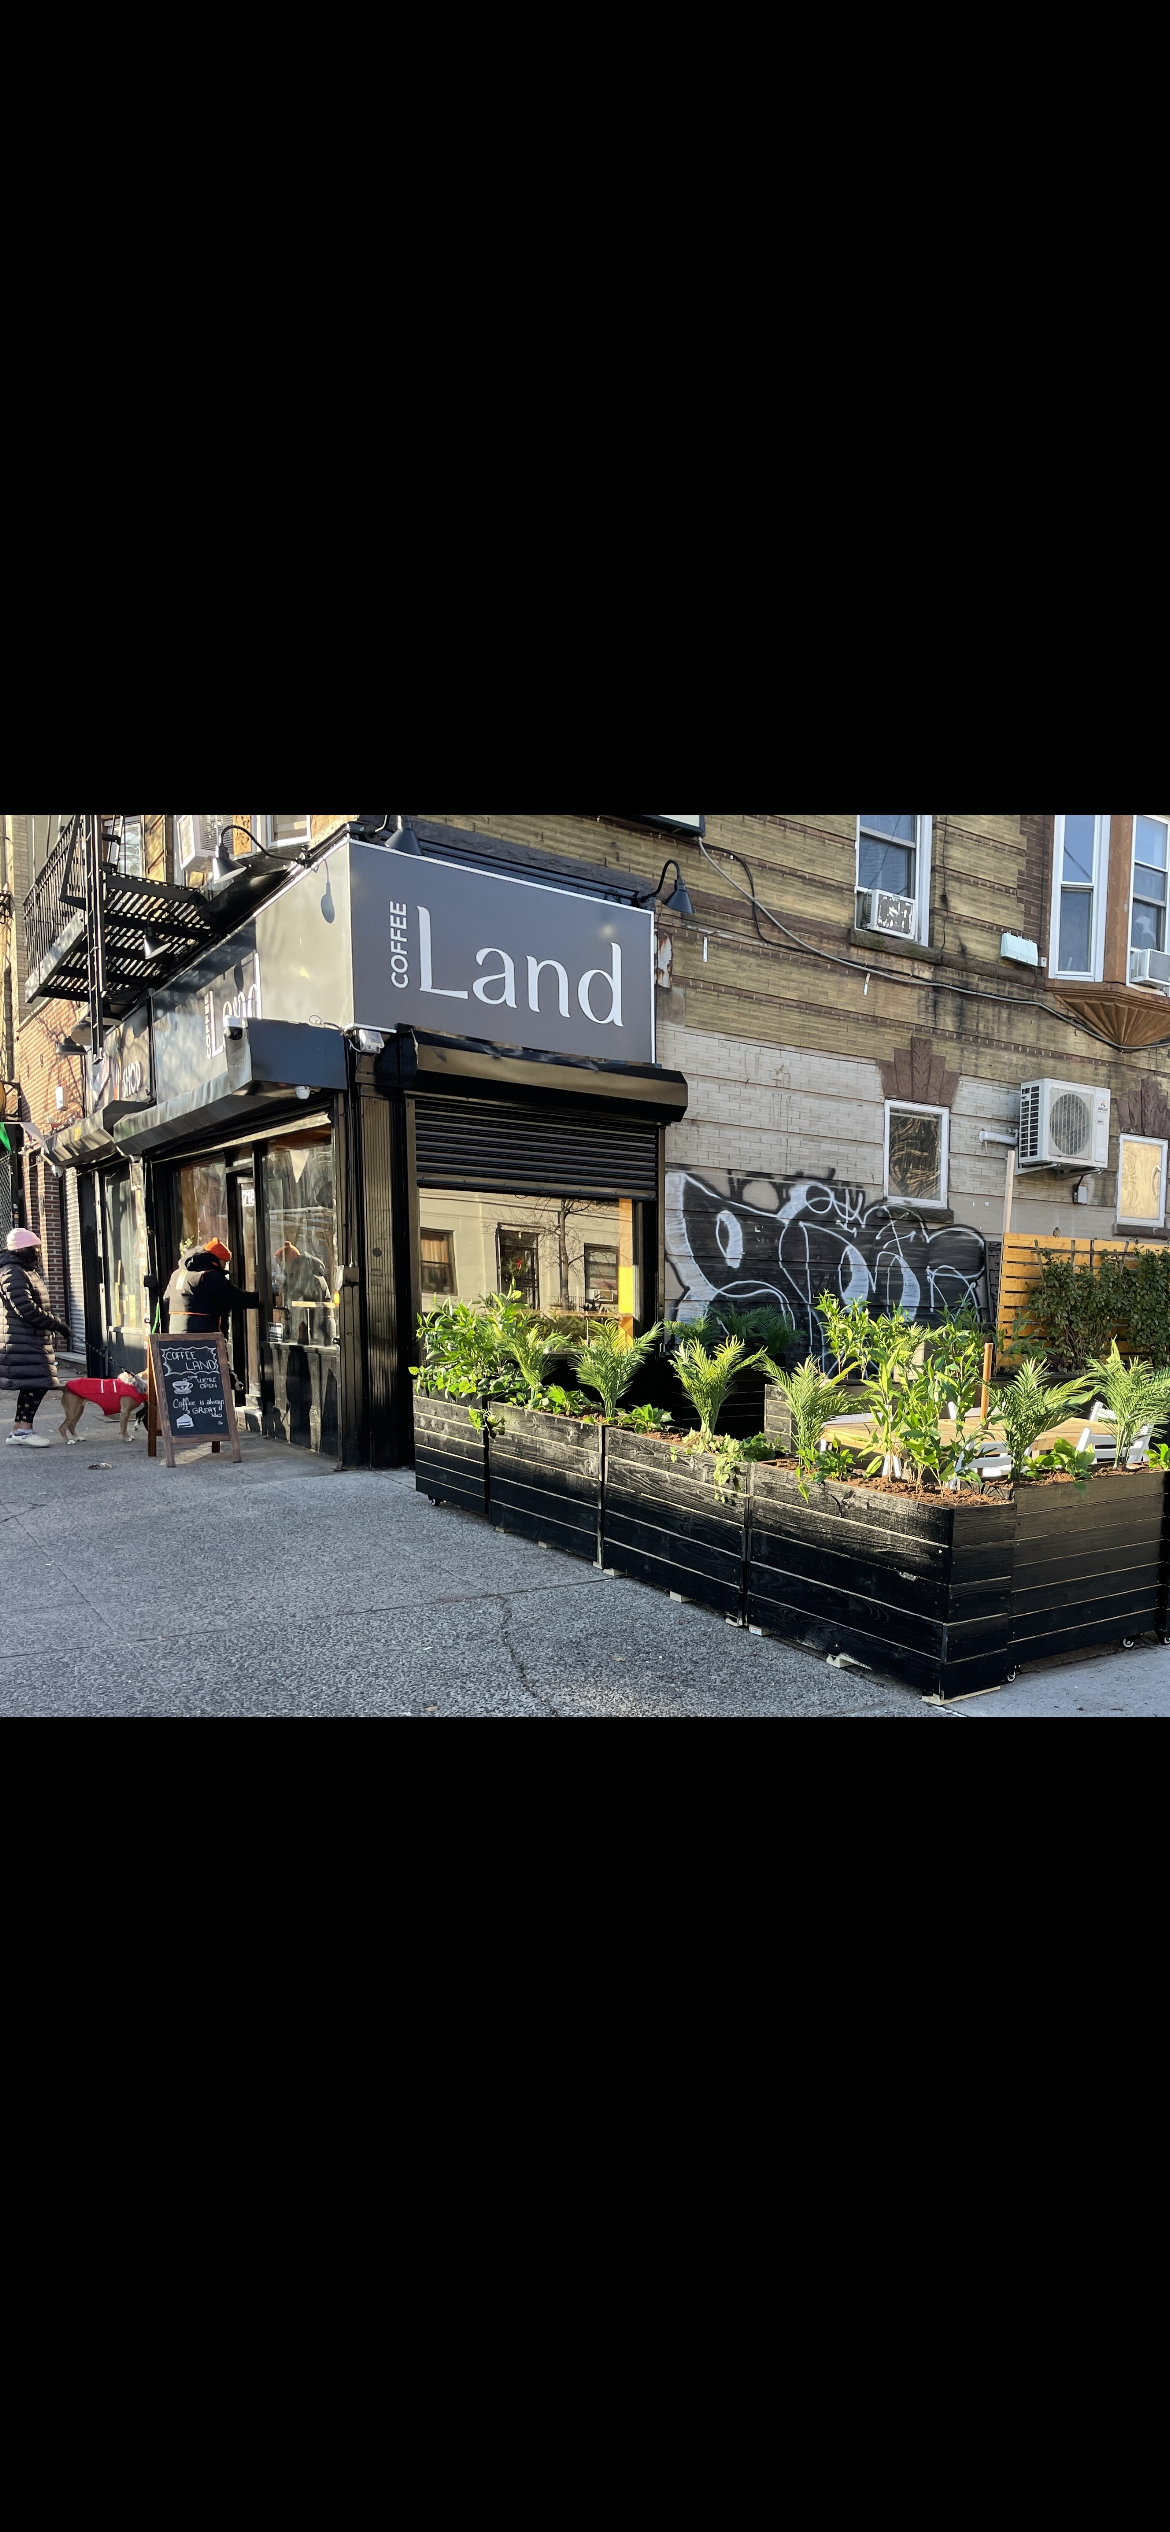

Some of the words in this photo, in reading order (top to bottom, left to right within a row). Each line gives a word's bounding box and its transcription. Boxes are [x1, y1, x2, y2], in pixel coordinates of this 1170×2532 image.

[389, 900, 409, 989] COFFEE
[416, 905, 624, 1027] Land
[166, 1351, 197, 1360] COFFEE
[185, 1360, 216, 1371] LAND
